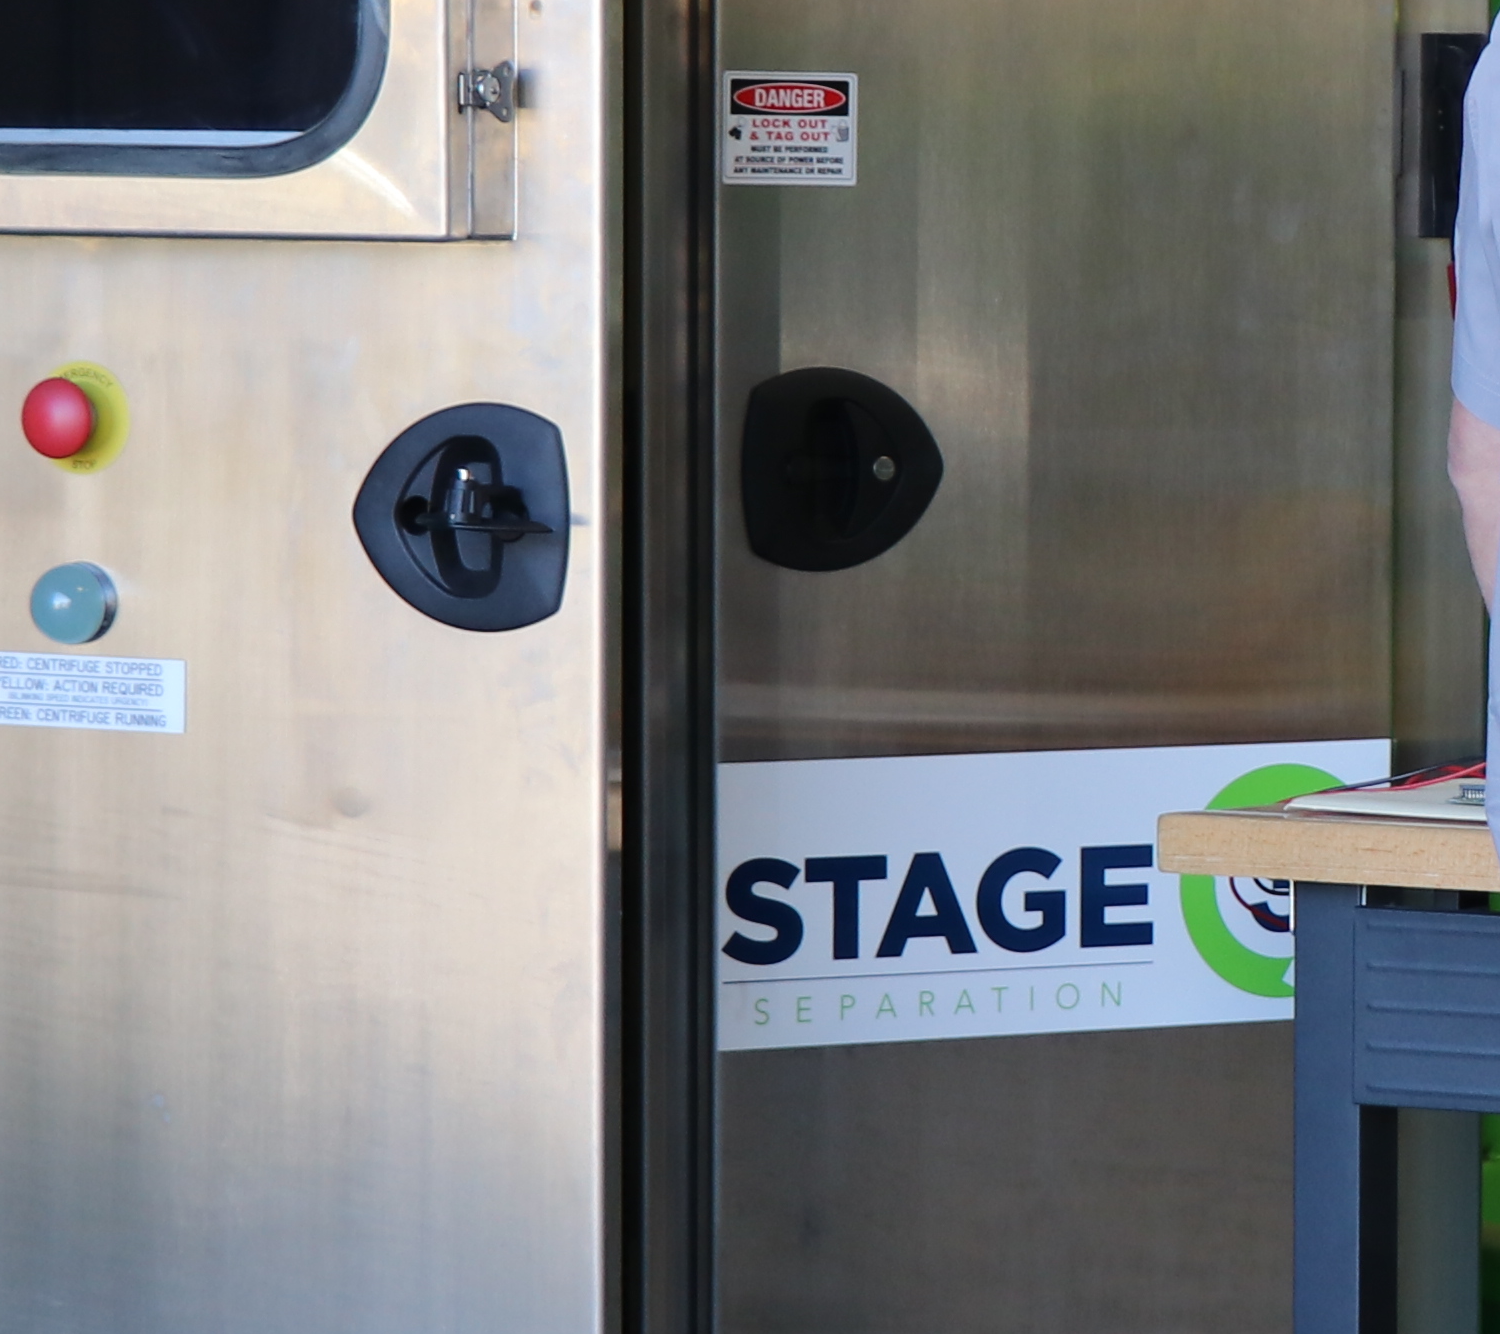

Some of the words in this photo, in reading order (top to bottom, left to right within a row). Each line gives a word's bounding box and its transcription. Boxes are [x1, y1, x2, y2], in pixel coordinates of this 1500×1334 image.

[754, 89, 825, 108] DANGER
[752, 119, 791, 128] LOCK
[798, 119, 828, 128] OUT
[750, 131, 759, 140] &
[766, 131, 794, 140] TAG
[800, 132, 831, 141] OUT
[58, 368, 113, 386] ERGENCY
[27, 657, 100, 673] CENTRIFUGE
[105, 661, 163, 676] STOPPED
[53, 679, 98, 693] ACTION
[102, 682, 164, 697] REQUIRED
[36, 708, 110, 725] CENTRIFUGE
[115, 712, 167, 727] RUNNING
[721, 844, 1154, 965] STAGE
[753, 980, 1124, 1026] SEPARATION
